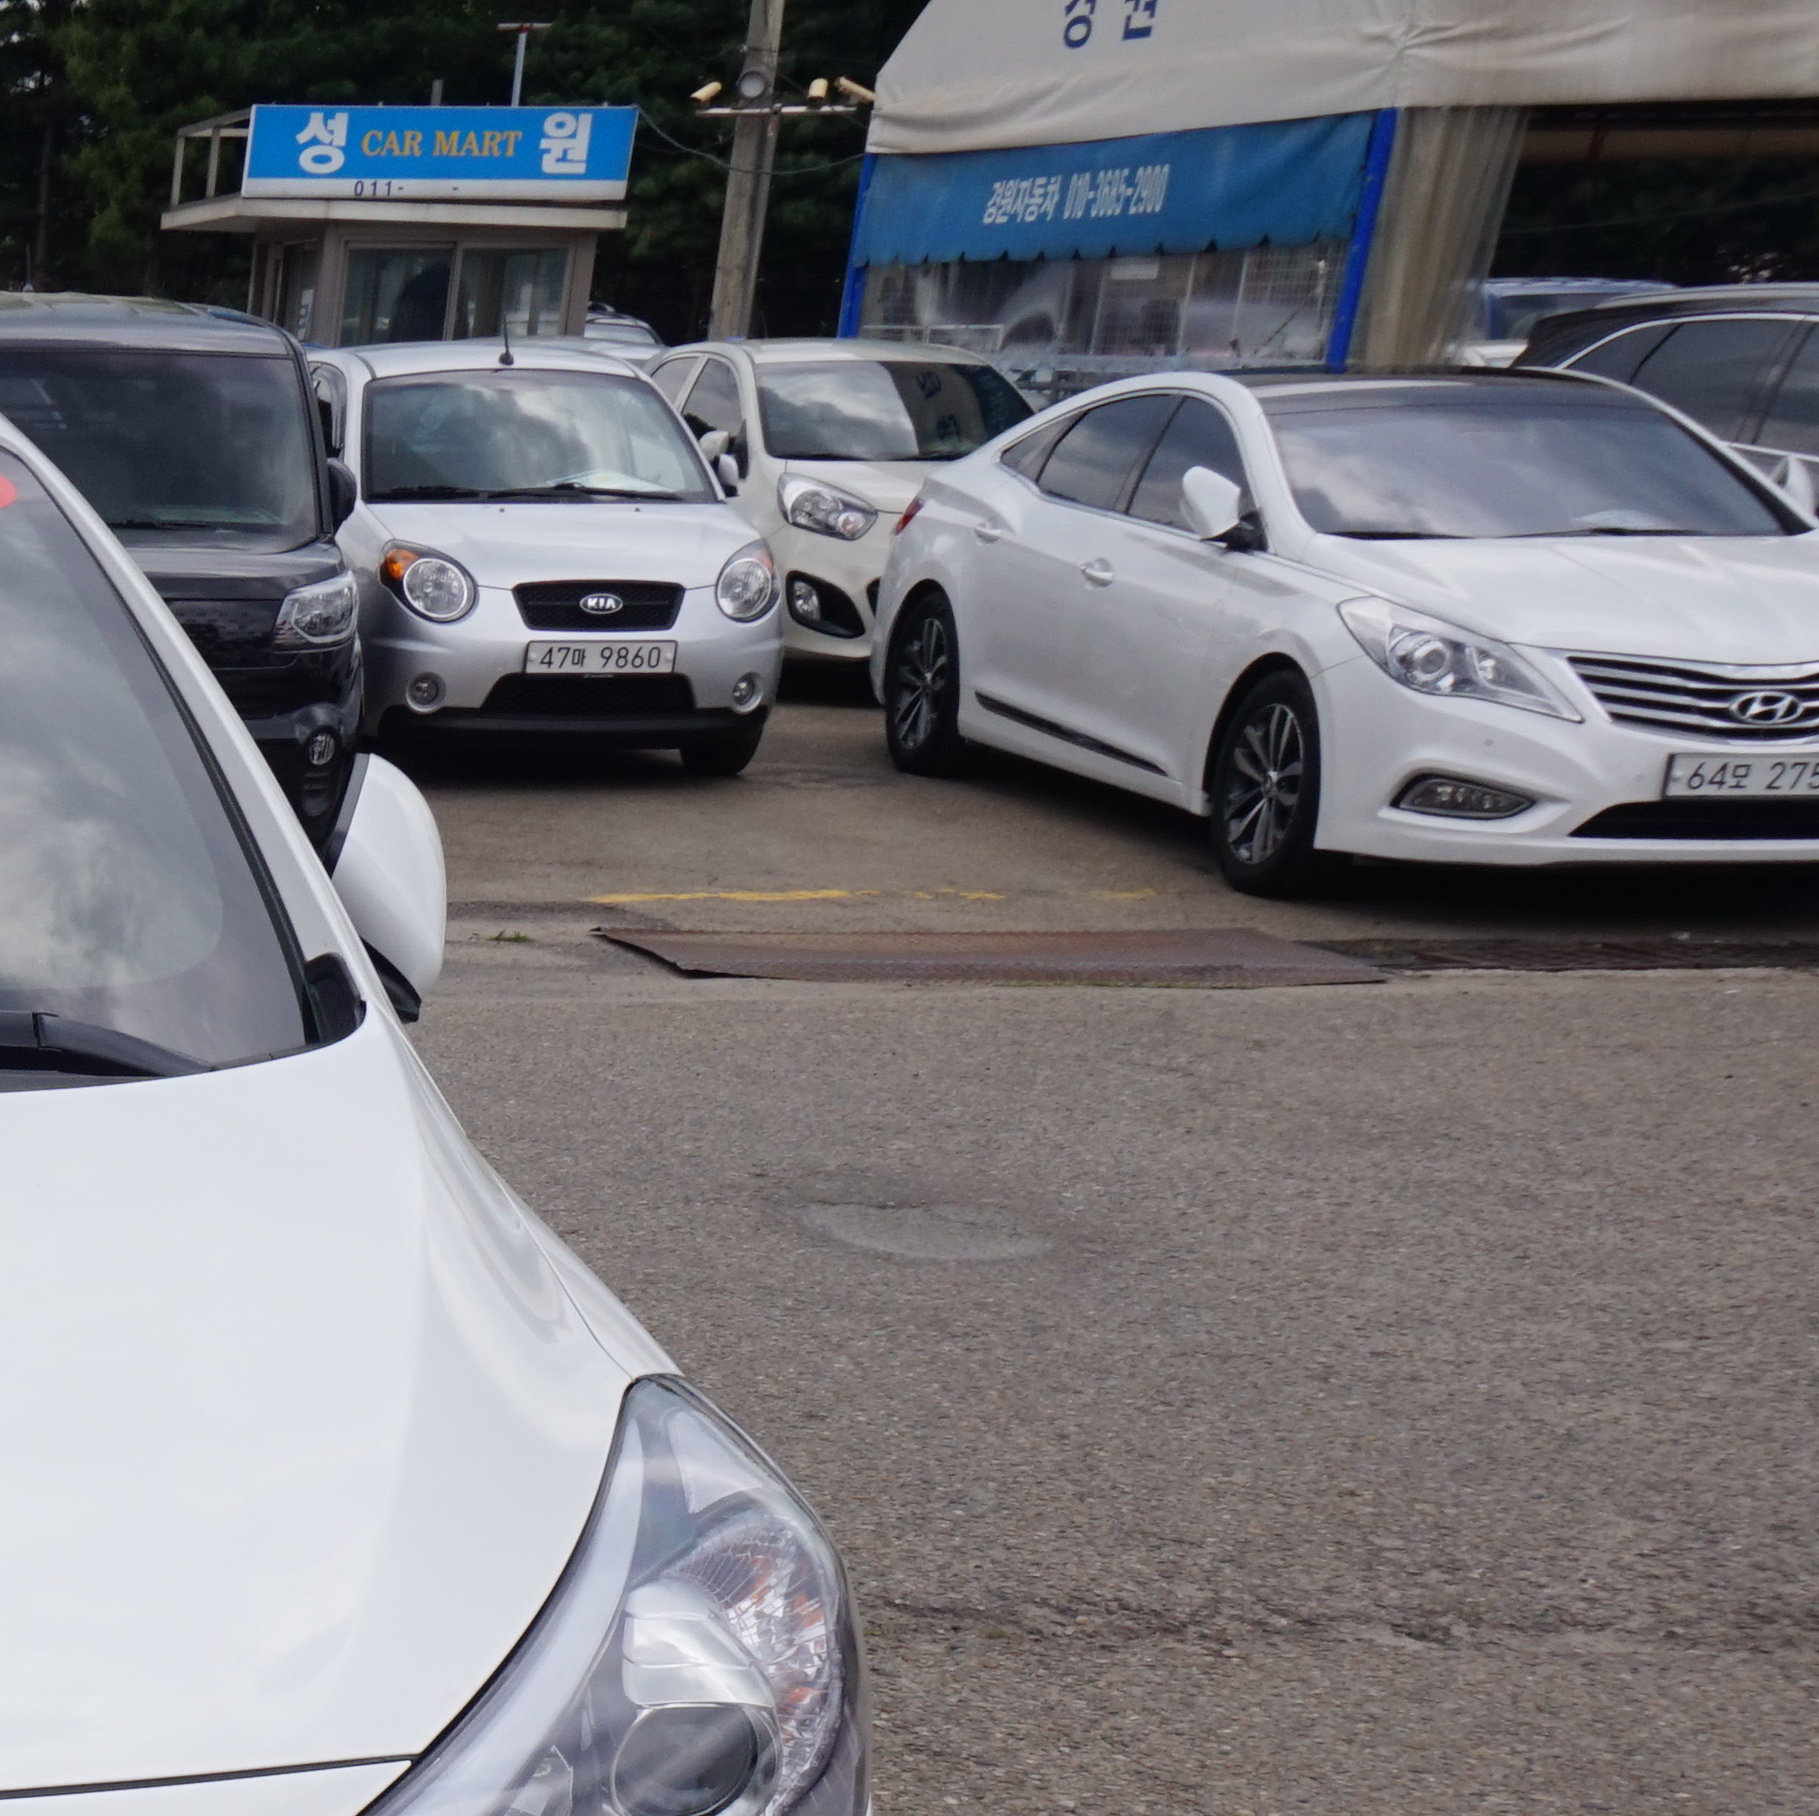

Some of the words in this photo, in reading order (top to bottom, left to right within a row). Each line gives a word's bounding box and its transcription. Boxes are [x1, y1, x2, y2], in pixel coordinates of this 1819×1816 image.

[295, 110, 349, 175] 성
[361, 129, 423, 158] CAR
[432, 129, 523, 158] MART
[539, 111, 593, 176] 원
[538, 645, 588, 670] 47마
[599, 645, 662, 670] 9860
[1686, 761, 1753, 791] 64모
